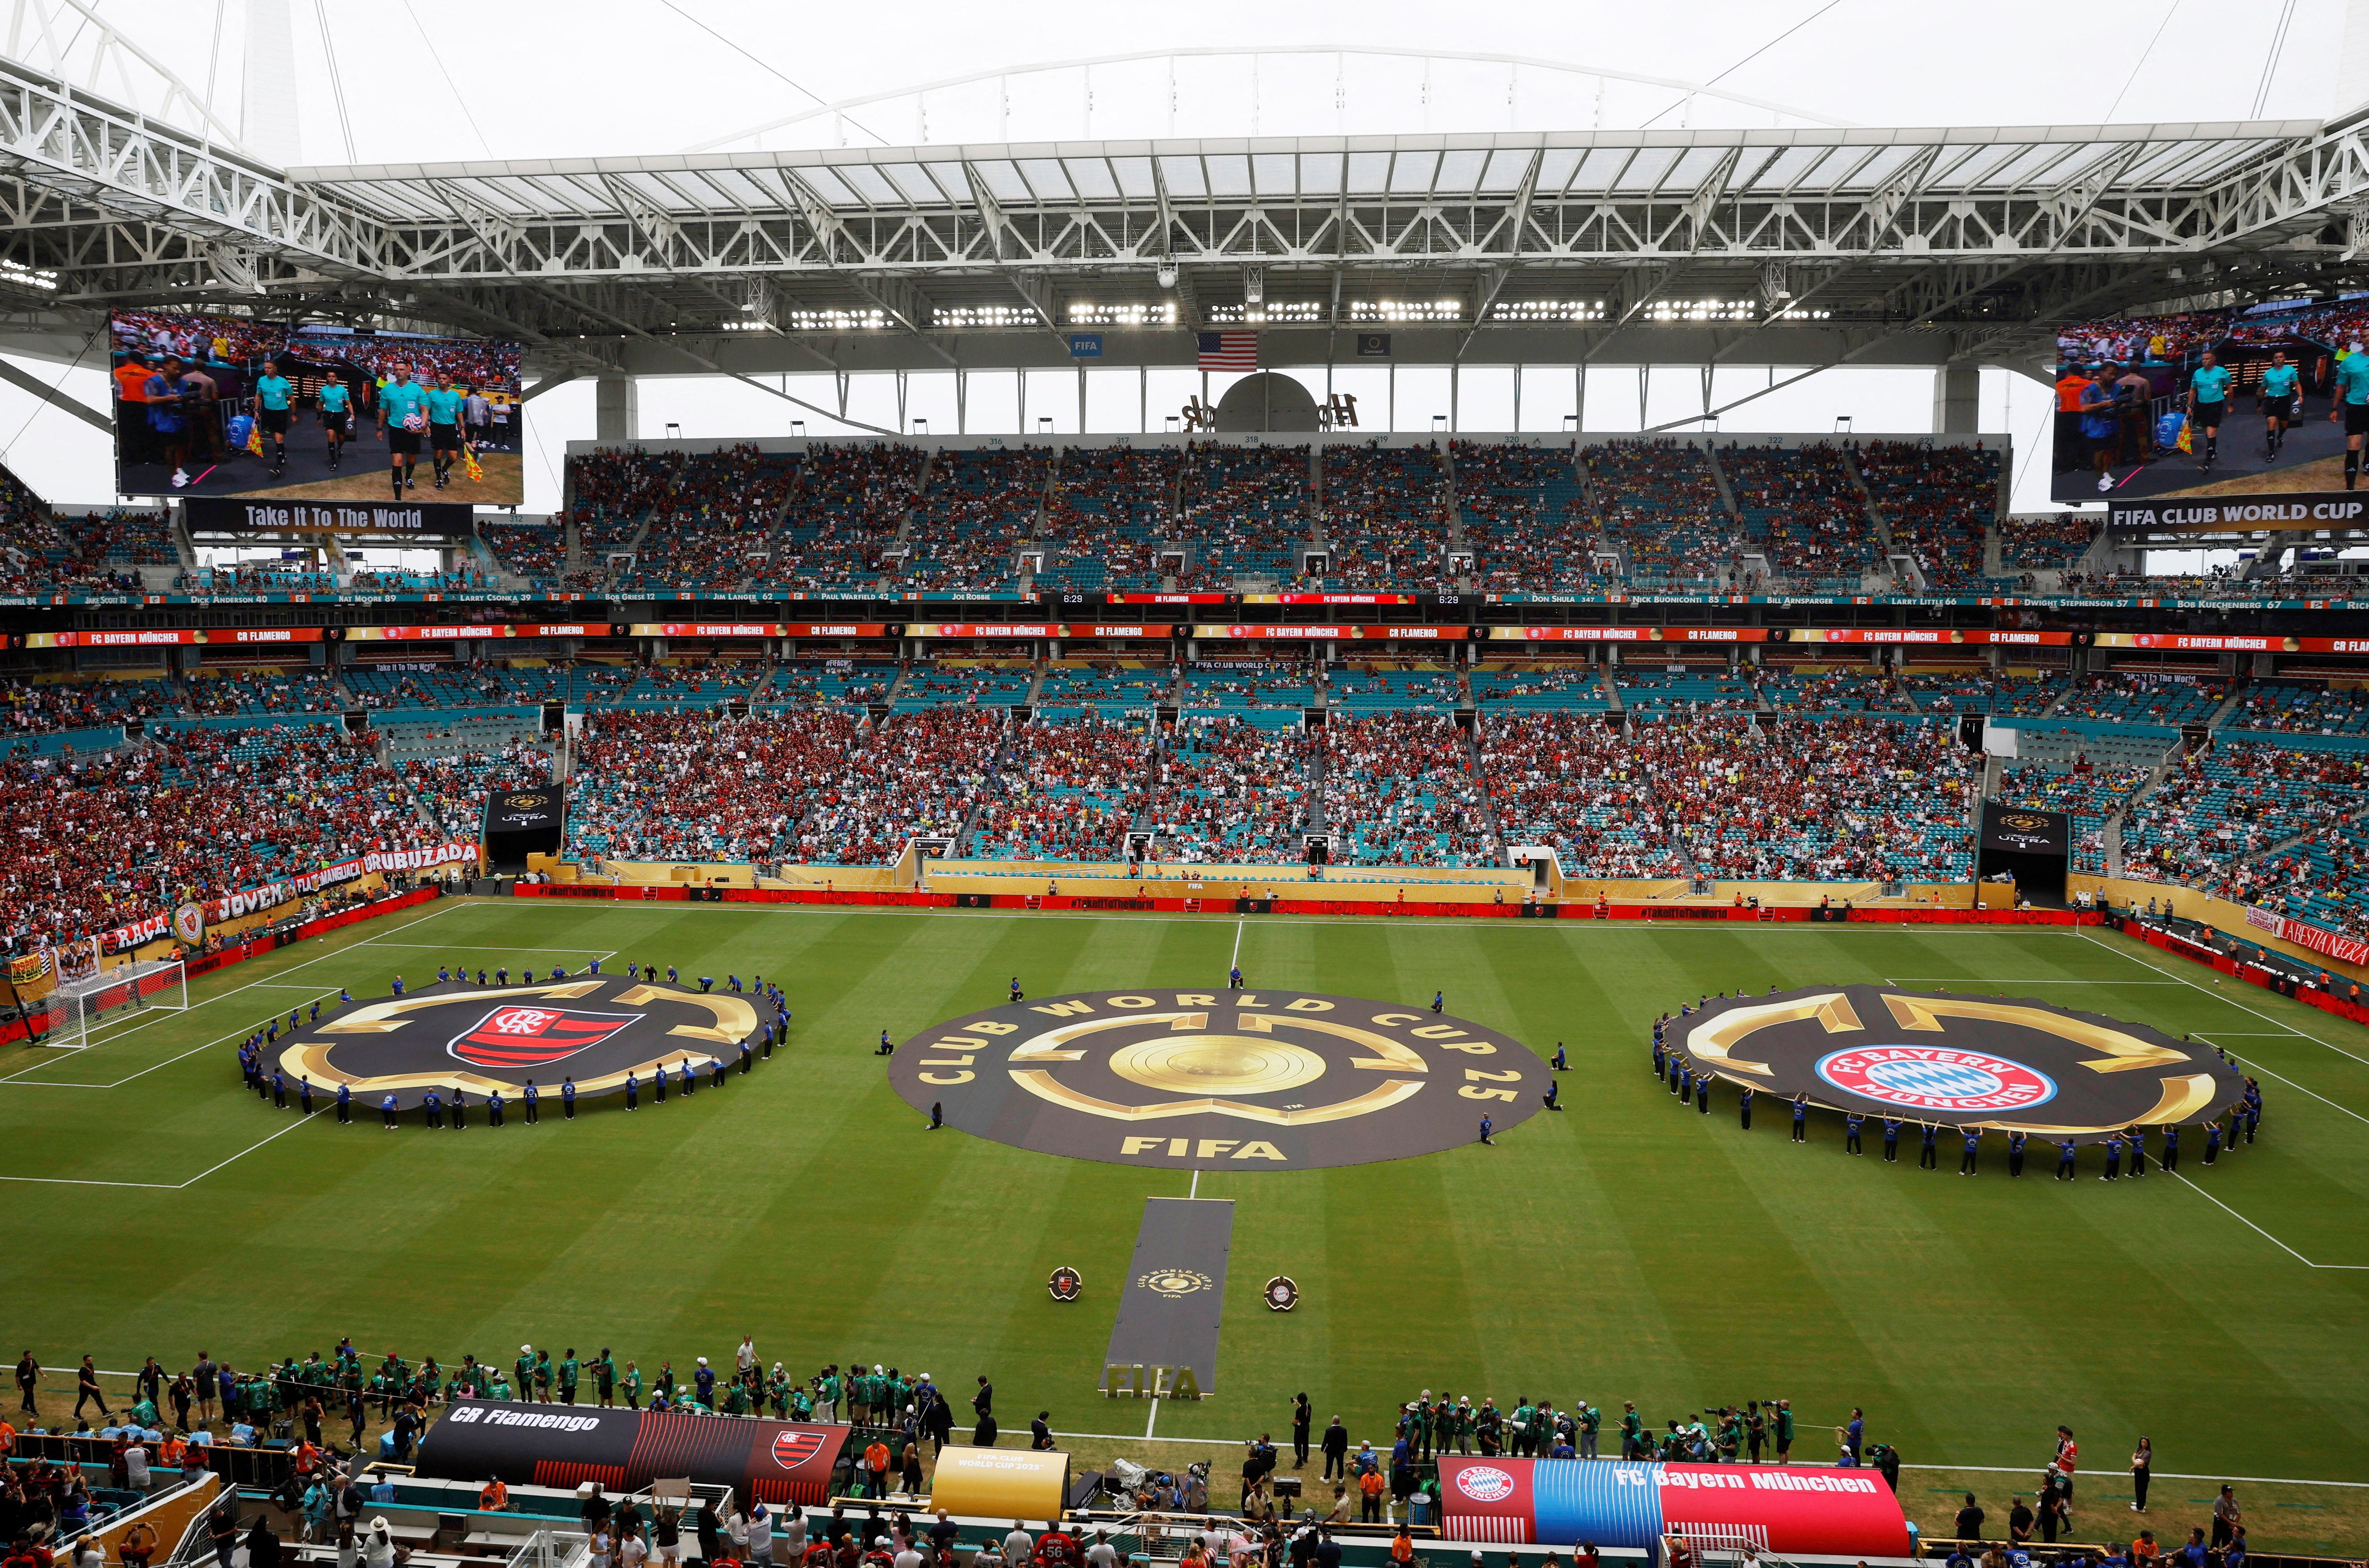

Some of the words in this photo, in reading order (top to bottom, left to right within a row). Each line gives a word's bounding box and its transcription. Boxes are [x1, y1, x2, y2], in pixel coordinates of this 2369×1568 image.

[246, 506, 288, 525] Take
[295, 507, 306, 526] It
[312, 508, 331, 526] To
[337, 509, 368, 527] The
[373, 509, 421, 528] World
[2114, 510, 2157, 525] FIFA
[2162, 508, 2217, 524] CLUB
[2223, 504, 2307, 521] WORLD
[2314, 503, 2362, 519] CUP
[1351, 594, 1375, 603] MÜNCHEN
[2199, 600, 2262, 609] KUECHENBERG
[238, 632, 247, 640] CR
[250, 631, 290, 640] FLAMENGO
[421, 629, 429, 637] FC
[432, 628, 458, 637] BAYERN
[460, 626, 492, 636] MÜNCHEN
[1013, 625, 1045, 635] MÜNCHEN
[1575, 630, 1600, 638] BAYERN
[1603, 628, 1636, 638] MÜNCHEN
[92, 635, 102, 643] FC
[105, 634, 136, 643] BAYERN
[139, 632, 178, 643] MÜNCHEN
[2002, 633, 2039, 643] FLAMENGO
[2178, 638, 2188, 647] FC
[2191, 638, 2222, 648] BAYERN
[2225, 637, 2266, 648] MÜNCHEN
[2334, 641, 2346, 651] CR
[376, 664, 390, 672] Take
[392, 663, 397, 672] It
[407, 663, 418, 671] The
[363, 844, 478, 873] URUBUZADA
[217, 883, 284, 920] JOVEM
[1641, 907, 1728, 919] #TakeItToTheWorld
[2281, 920, 2293, 939] LA
[2294, 924, 2328, 953] BESTIA
[2326, 937, 2369, 965] NEGRA
[918, 1021, 1019, 1086] CLUB
[1029, 993, 1335, 1018] WORLD
[1370, 1014, 1498, 1055] CUP
[1457, 1068, 1522, 1103] 25
[1832, 1058, 1866, 1074] FC
[1862, 1049, 2016, 1074] BAYERN
[1852, 1083, 2039, 1108] MÜNCHEN
[1120, 1137, 1288, 1162] FIFA
[1137, 1274, 1149, 1288] CLUB
[1196, 1273, 1211, 1285] CUP
[1106, 1364, 1201, 1401] FIFA
[449, 1406, 489, 1425] CR
[491, 1409, 600, 1432] Flamengo
[1461, 1471, 1471, 1480] FC
[1470, 1469, 1509, 1481] BAYERN
[1614, 1468, 1645, 1486] FC
[1655, 1471, 1746, 1491] Bayern
[1750, 1471, 1877, 1494] München
[1046, 1546, 1062, 1558] 56
